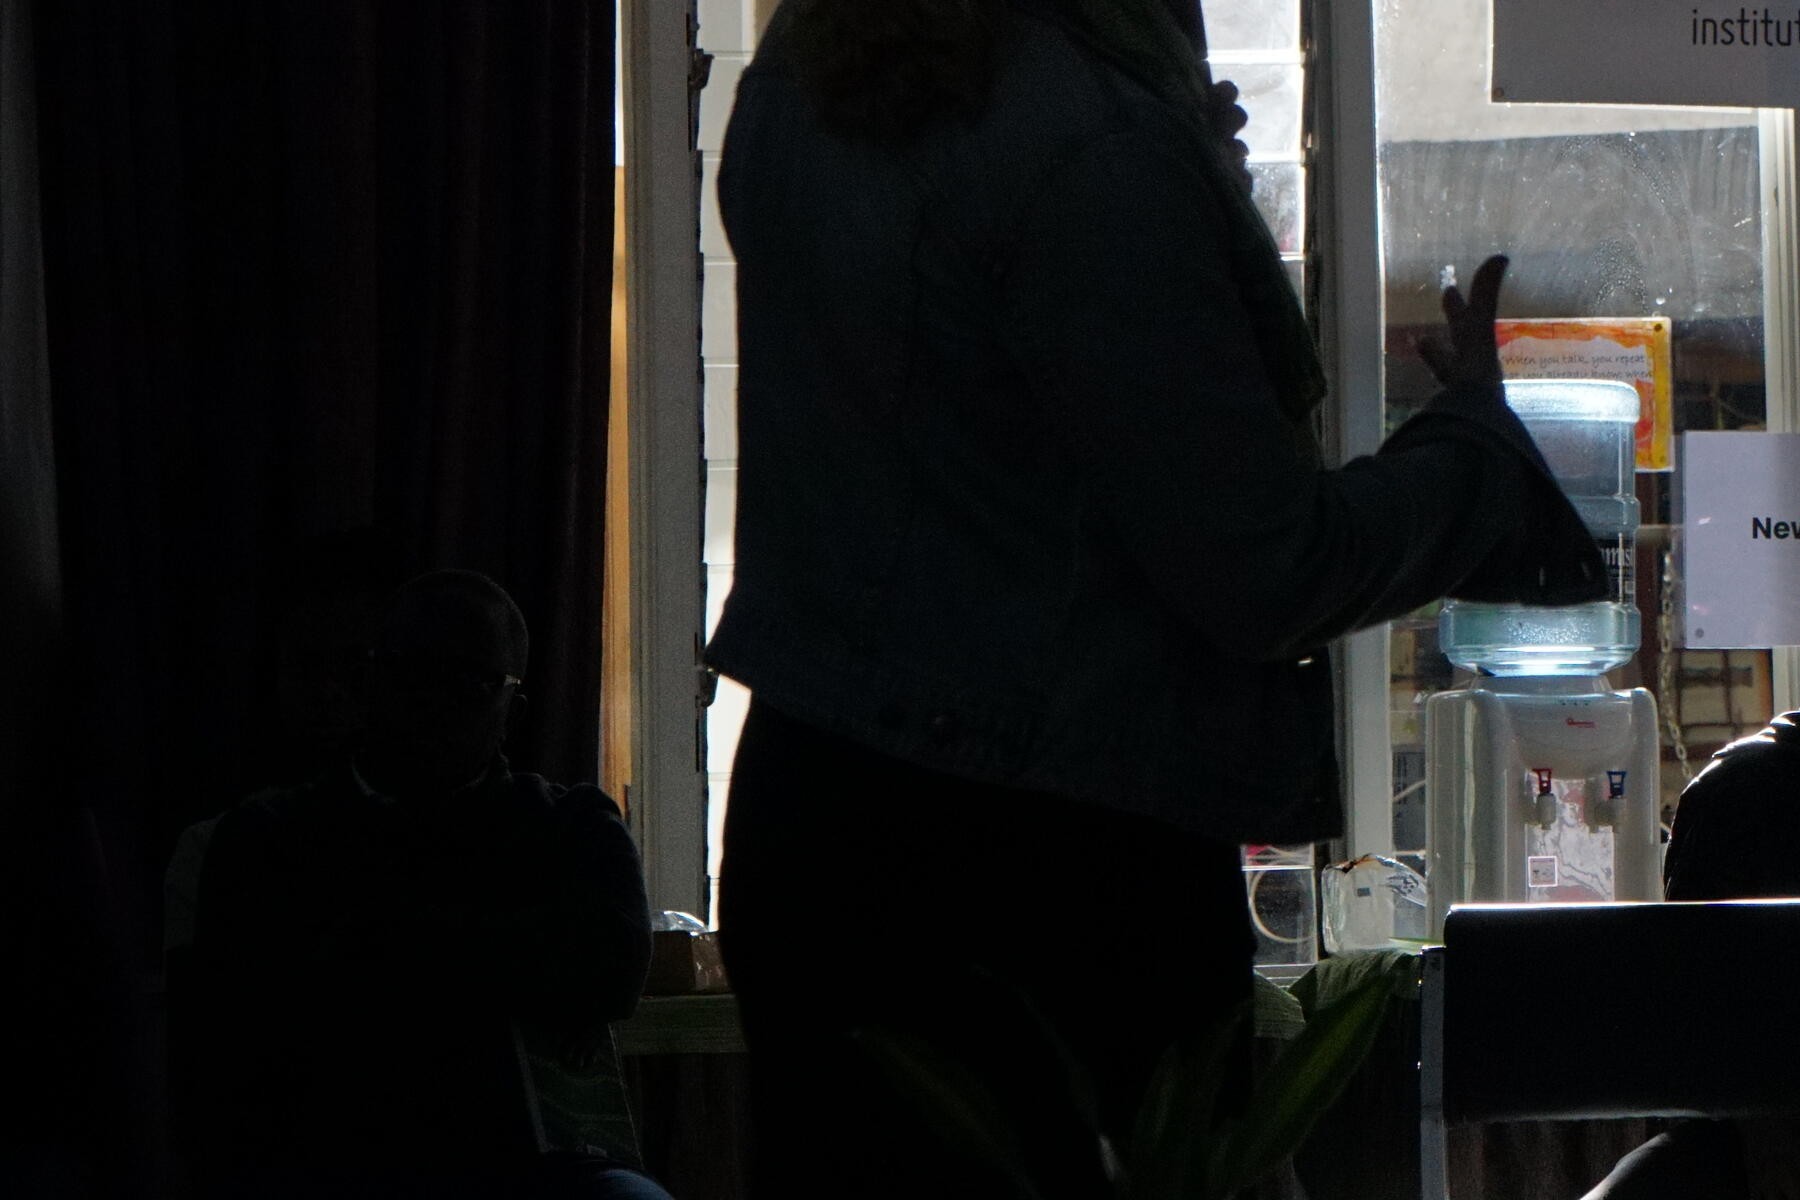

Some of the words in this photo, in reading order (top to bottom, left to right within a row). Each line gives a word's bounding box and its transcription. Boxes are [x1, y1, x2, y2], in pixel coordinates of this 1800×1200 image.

[1539, 355, 1560, 369] you
[1591, 355, 1613, 369] you
[1615, 354, 1645, 367] repeat
